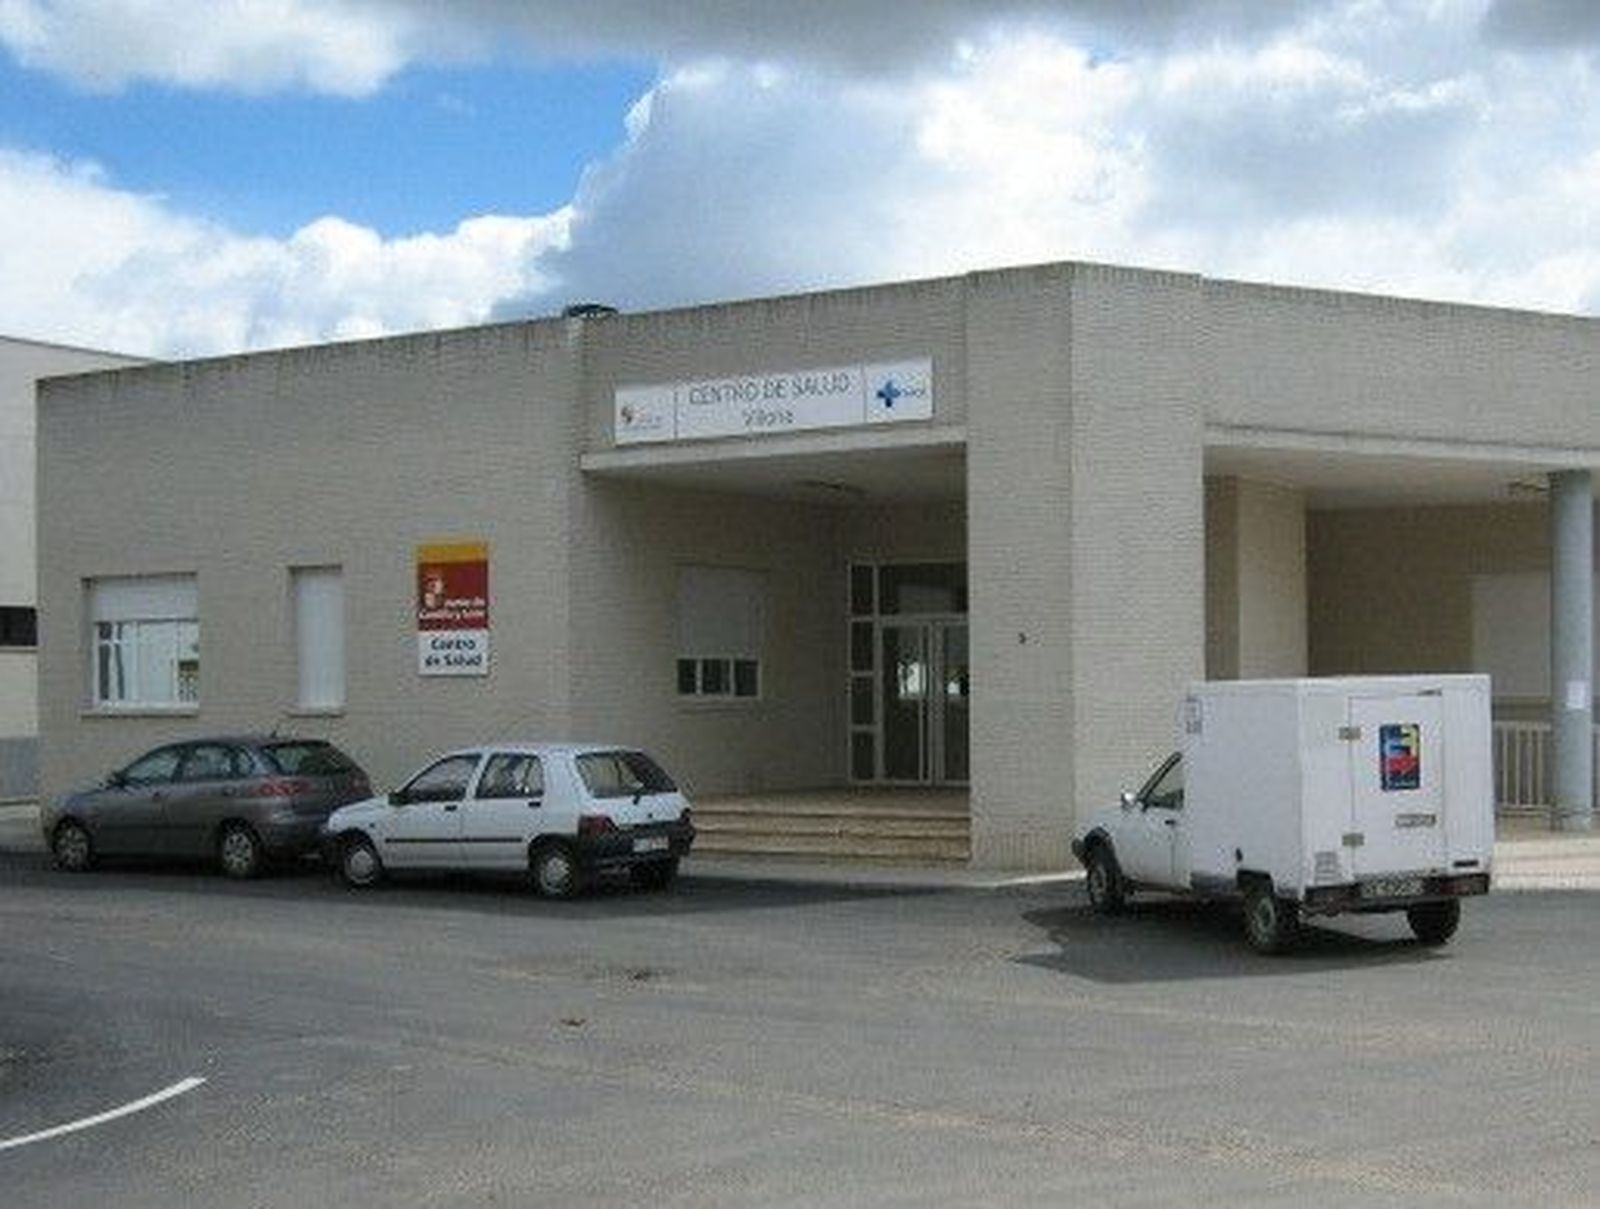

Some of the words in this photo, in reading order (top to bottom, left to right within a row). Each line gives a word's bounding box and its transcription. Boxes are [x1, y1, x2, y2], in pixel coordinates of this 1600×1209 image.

[689, 382, 762, 404] CENTRO
[764, 378, 791, 399] DE
[793, 373, 850, 396] SALUD
